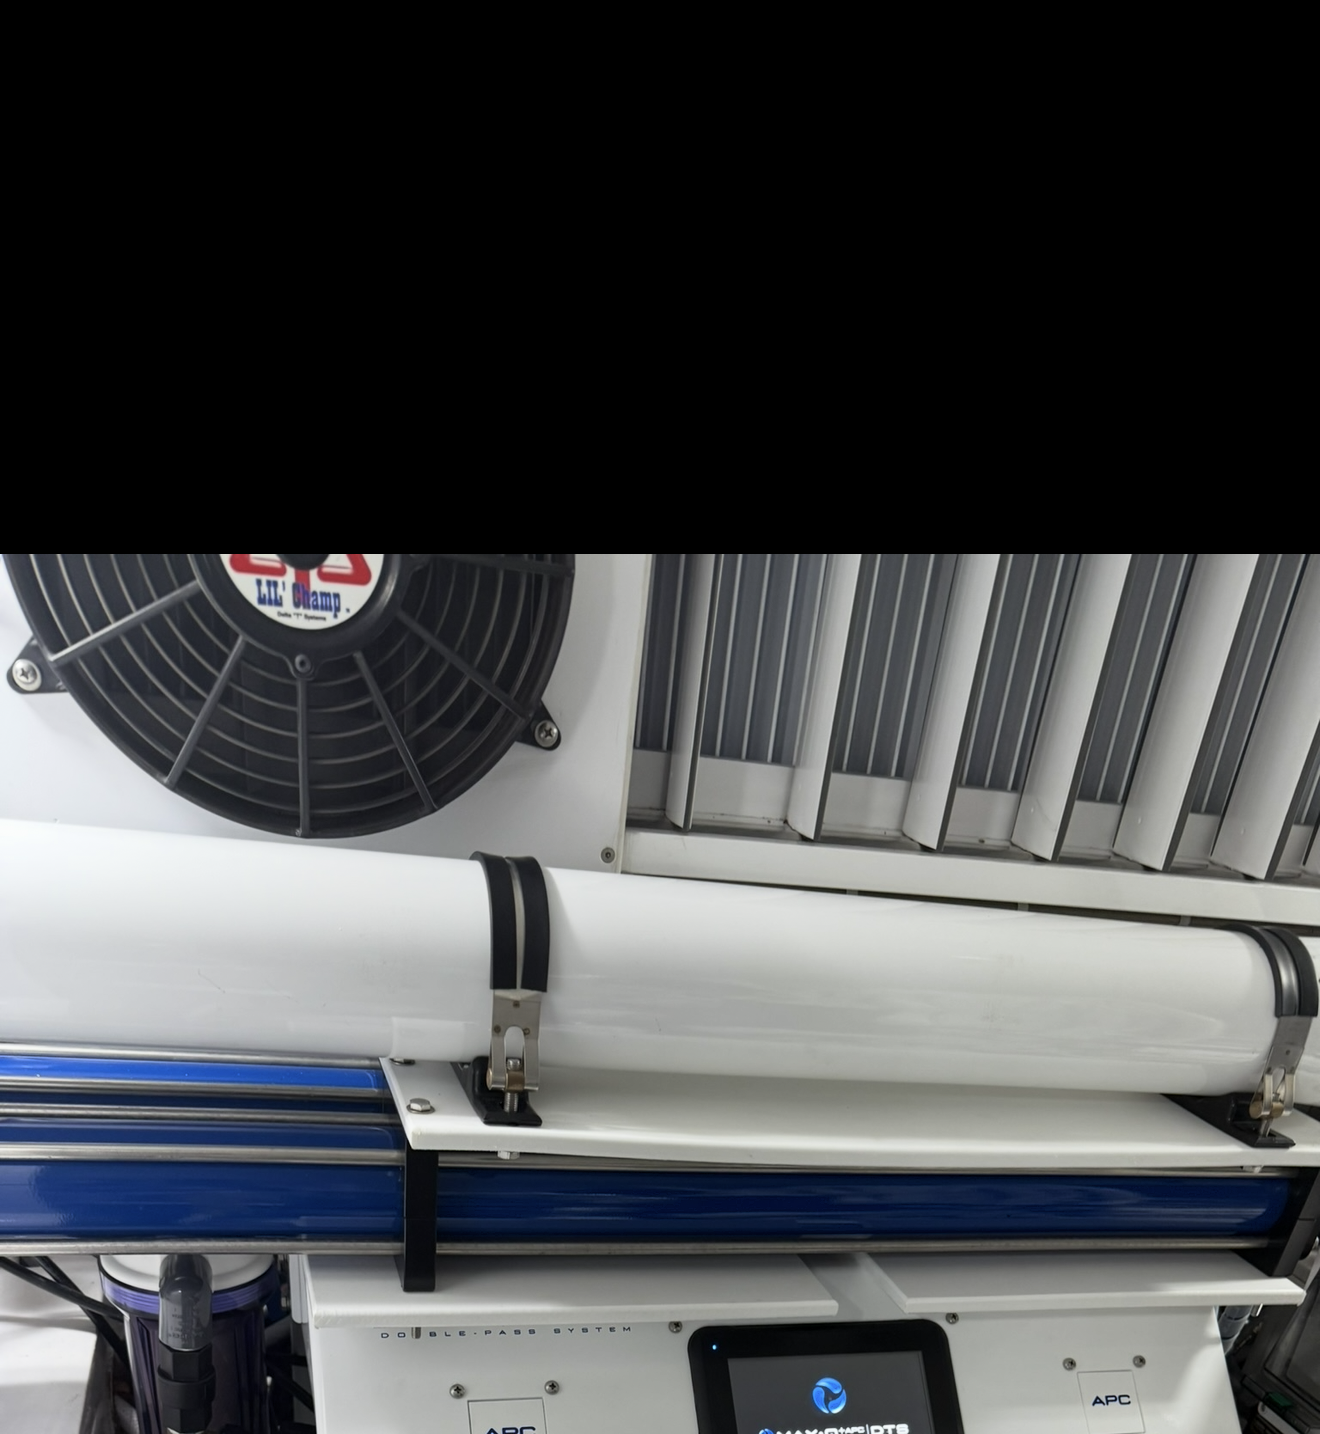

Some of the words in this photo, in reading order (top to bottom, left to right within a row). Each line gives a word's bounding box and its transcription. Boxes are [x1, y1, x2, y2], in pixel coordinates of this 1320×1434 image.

[292, 583, 341, 619] Champ
[303, 613, 327, 622] Systems
[380, 1328, 536, 1339] DOBLE-PASS
[553, 1326, 632, 1335] SYSTEM
[1092, 1394, 1131, 1406] APC
